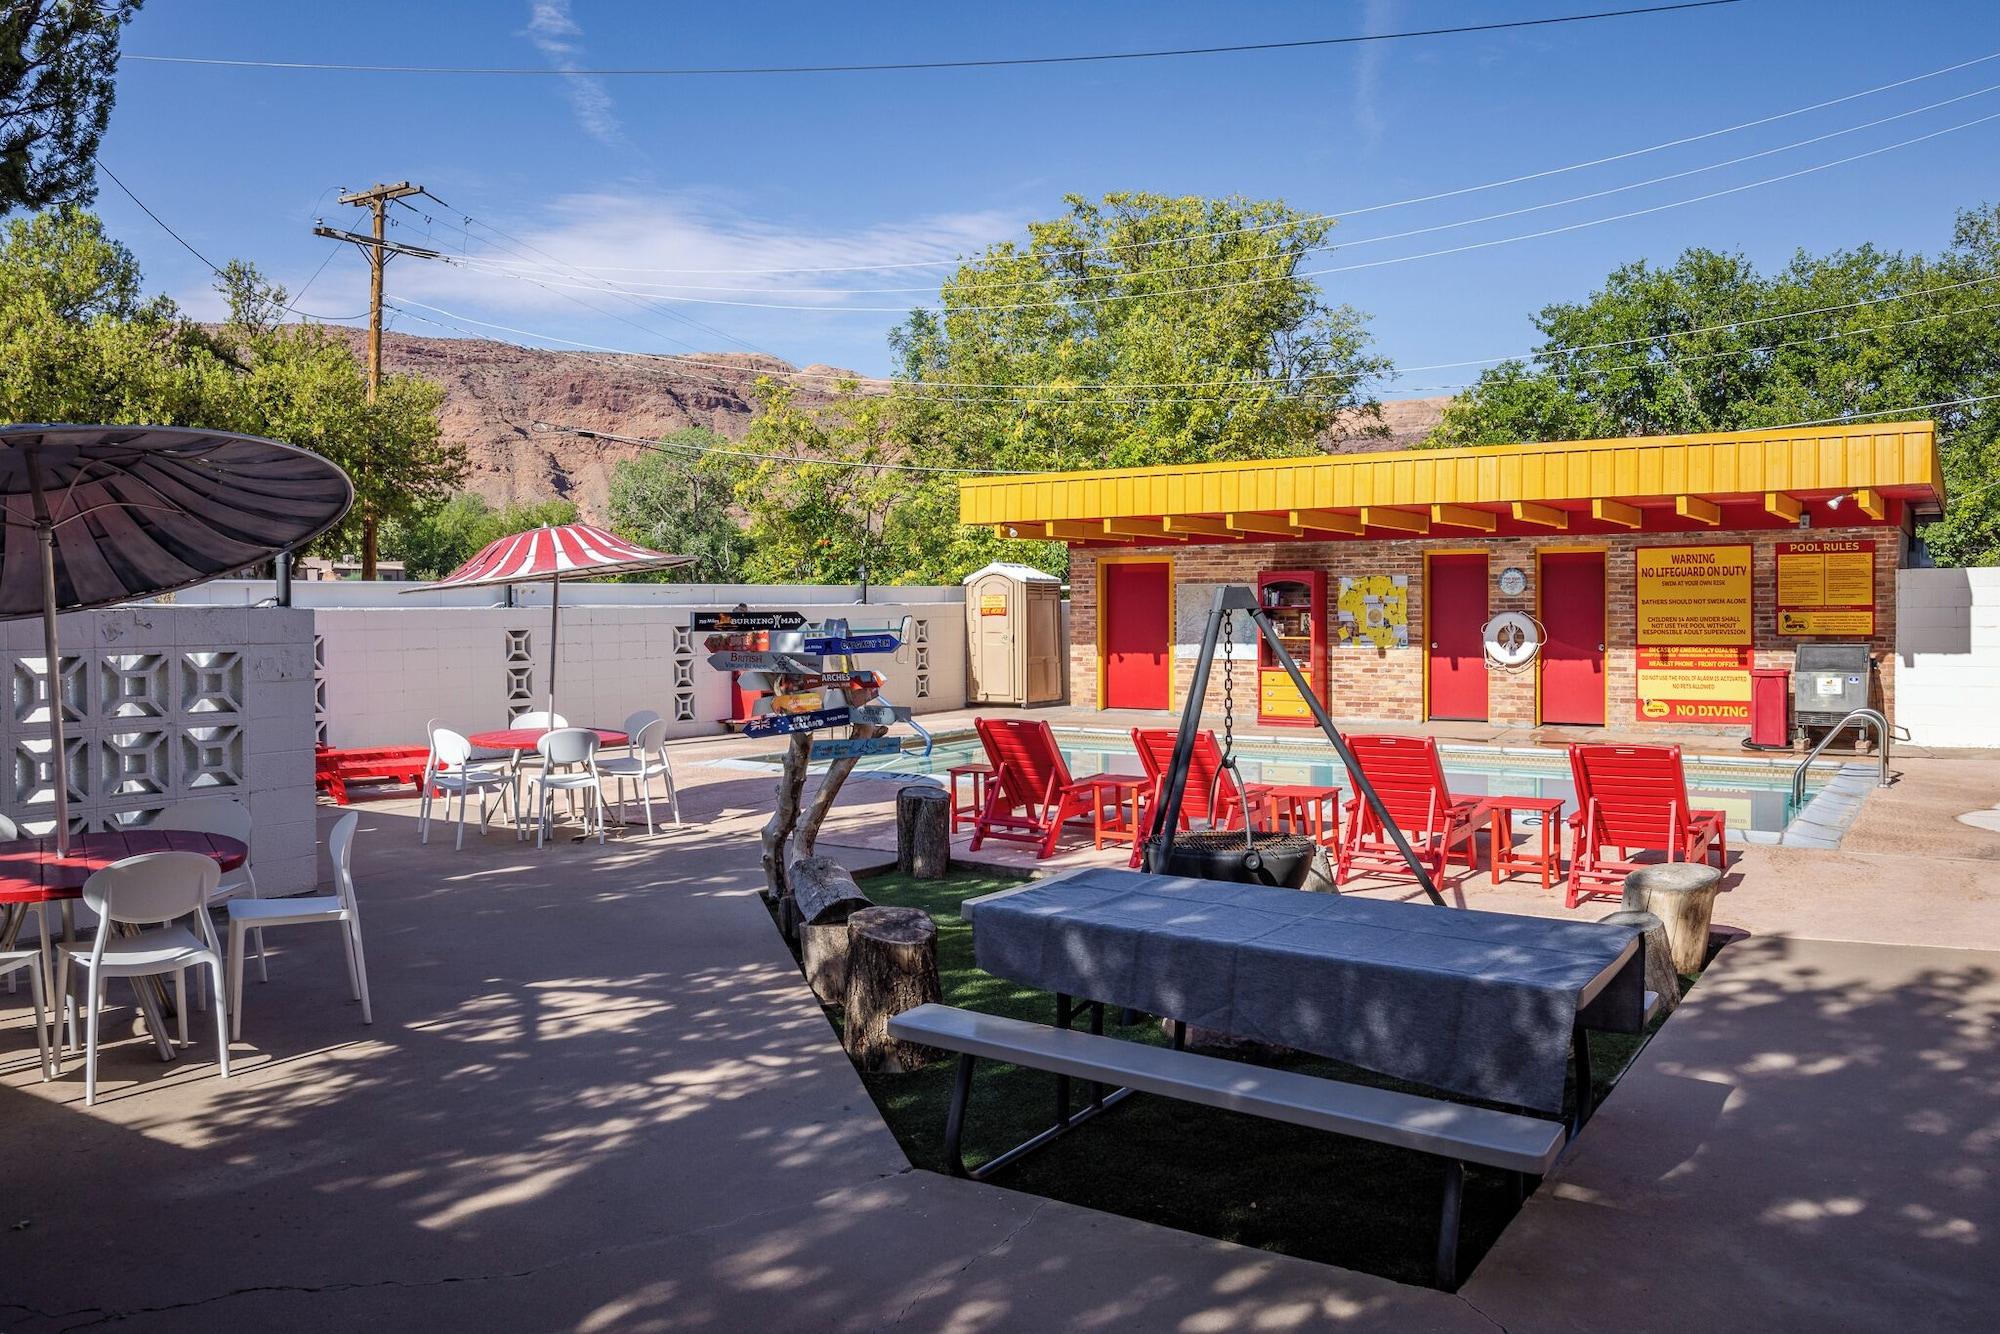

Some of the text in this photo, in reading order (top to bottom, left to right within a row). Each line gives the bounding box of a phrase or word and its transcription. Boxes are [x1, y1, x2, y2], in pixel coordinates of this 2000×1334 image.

[1790, 542, 1859, 552] POOL RULES
[1671, 553, 1715, 564] WARNING
[1641, 565, 1747, 578] NO LIFEGUARD ON DUTY
[731, 617, 774, 625] BURNING
[821, 673, 851, 682] ARCHES
[1676, 704, 1748, 717] NO DIVING
[788, 719, 824, 731] ZEALAND
